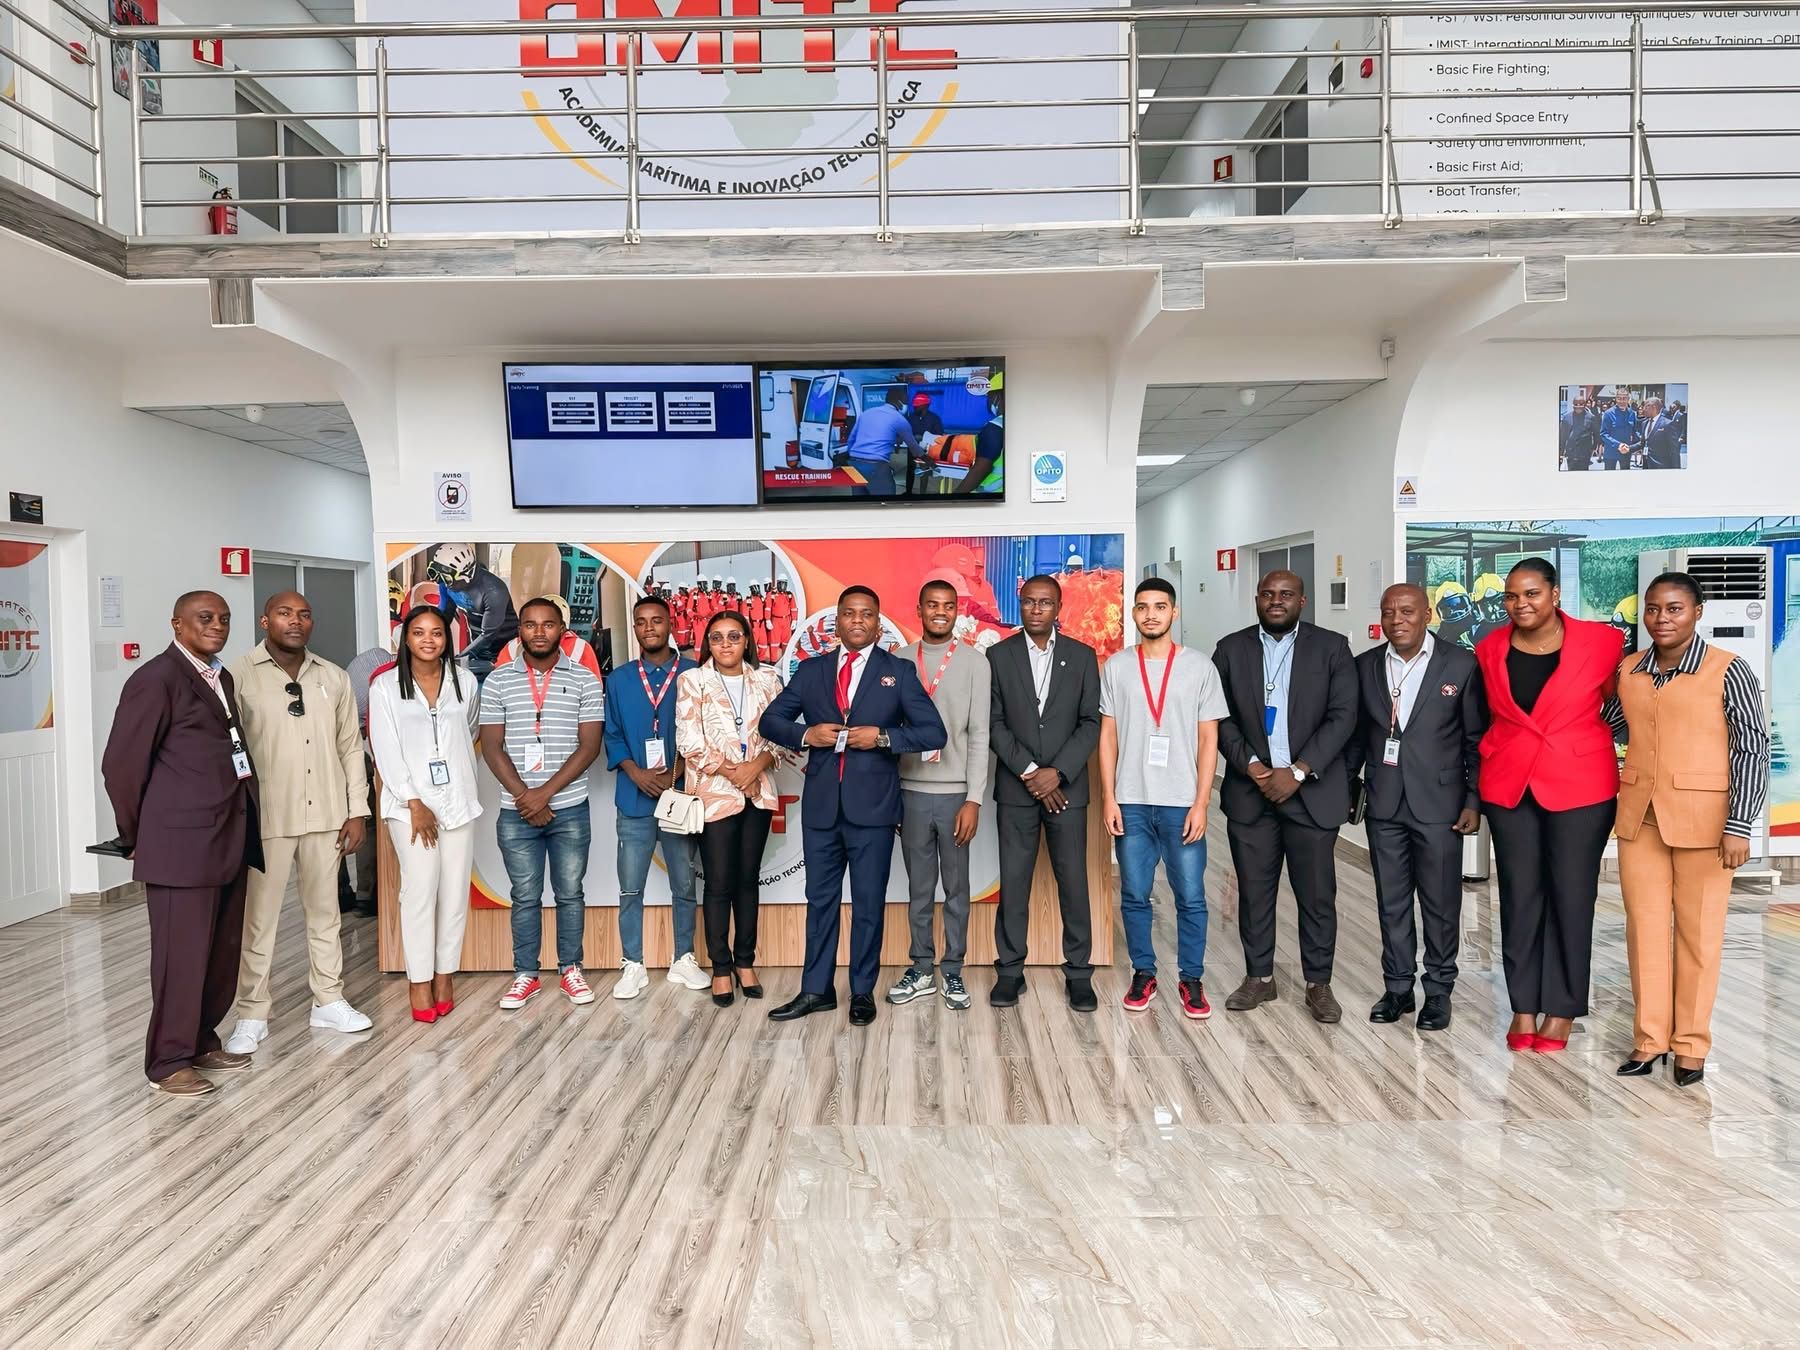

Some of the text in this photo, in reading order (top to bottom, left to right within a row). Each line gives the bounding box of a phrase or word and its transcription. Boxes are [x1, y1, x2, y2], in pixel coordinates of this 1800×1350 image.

[1474, 38, 1551, 48] International
[1555, 38, 1609, 47] Minimum
[1436, 63, 1550, 77] Basic Fire Fighting;
[1436, 111, 1569, 125] Confined Space Entry
[1436, 160, 1524, 172] Basic First Aid;
[718, 181, 727, 194] E
[733, 166, 825, 194] INOVAÇÃO
[1436, 185, 1520, 197] Boat Transfer;
[775, 473, 799, 481] RESCUE
[1036, 467, 1062, 475] OPITO
